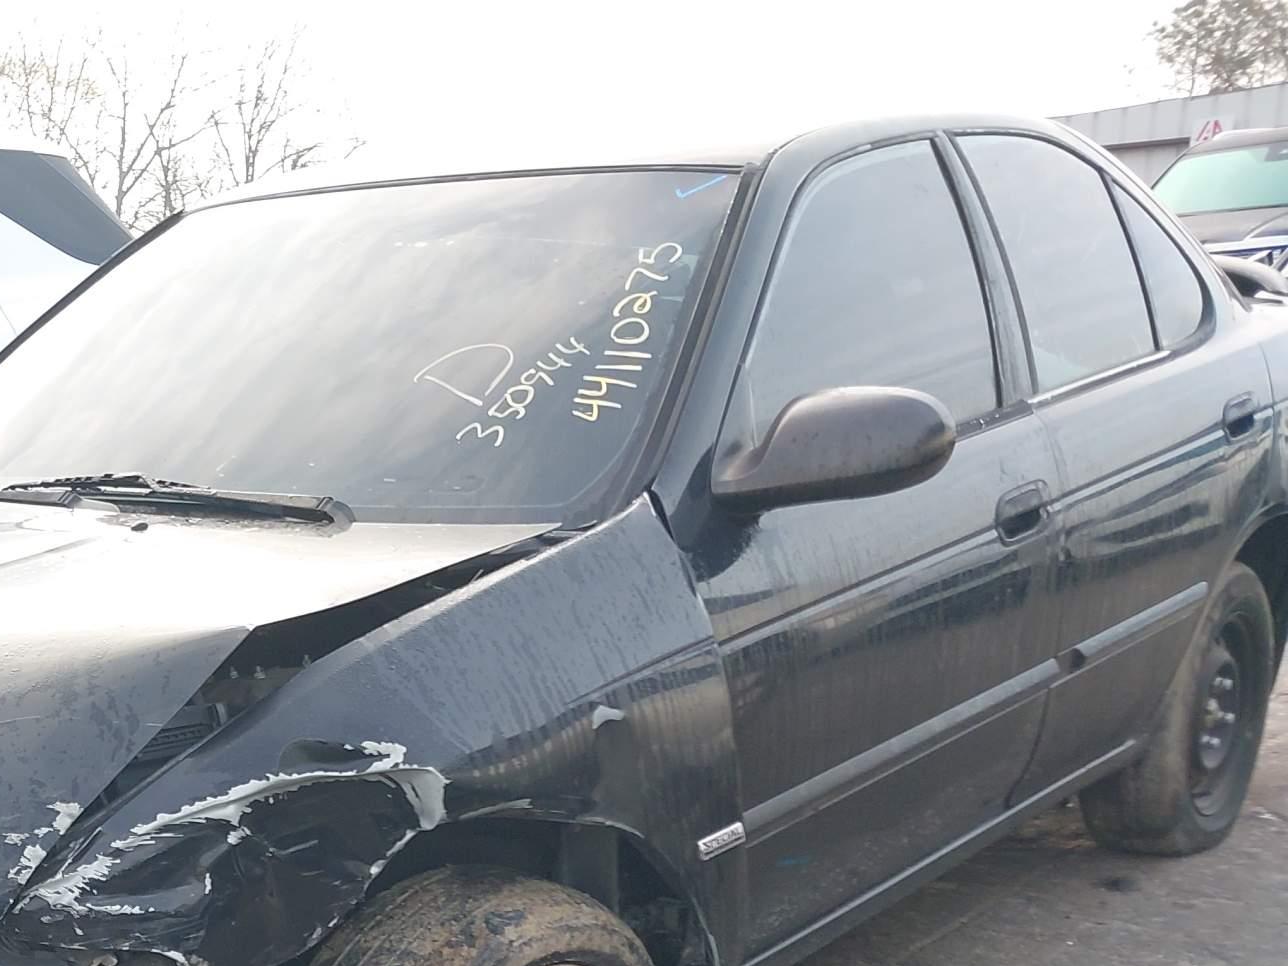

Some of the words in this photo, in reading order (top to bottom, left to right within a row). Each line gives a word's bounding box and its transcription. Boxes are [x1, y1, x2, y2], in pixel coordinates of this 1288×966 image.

[413, 343, 514, 407] D
[571, 242, 683, 422] 44110275
[454, 337, 591, 447] 350944
